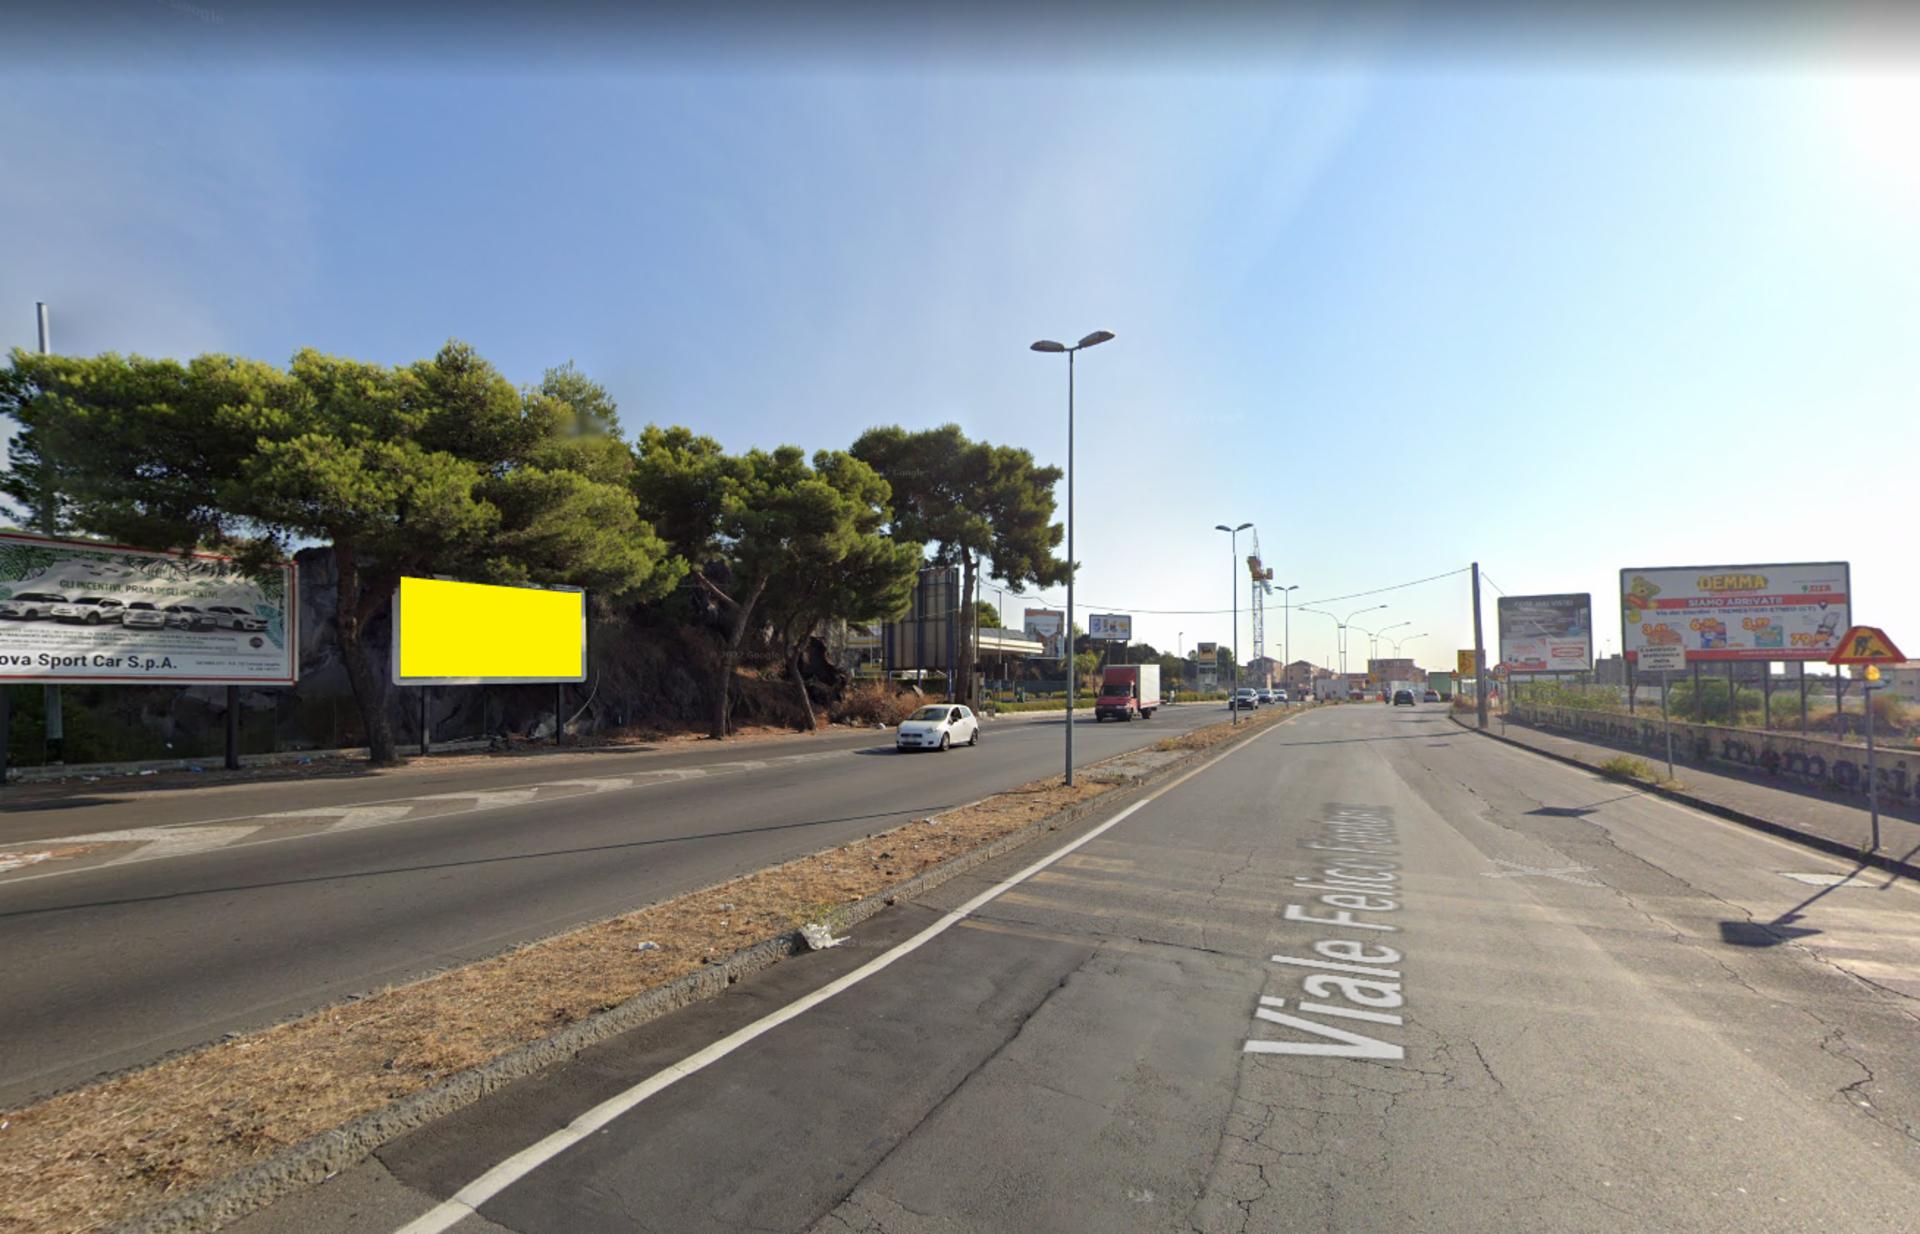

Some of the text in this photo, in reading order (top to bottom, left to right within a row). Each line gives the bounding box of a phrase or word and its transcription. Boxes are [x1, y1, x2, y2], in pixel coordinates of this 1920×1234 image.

[125, 584, 154, 594] PRIMA
[1688, 598, 1724, 607] SIAMO
[38, 653, 87, 669] Sport
[93, 654, 123, 668] Car
[127, 656, 177, 670] S.p.A.
[1720, 738, 1920, 797] memori
